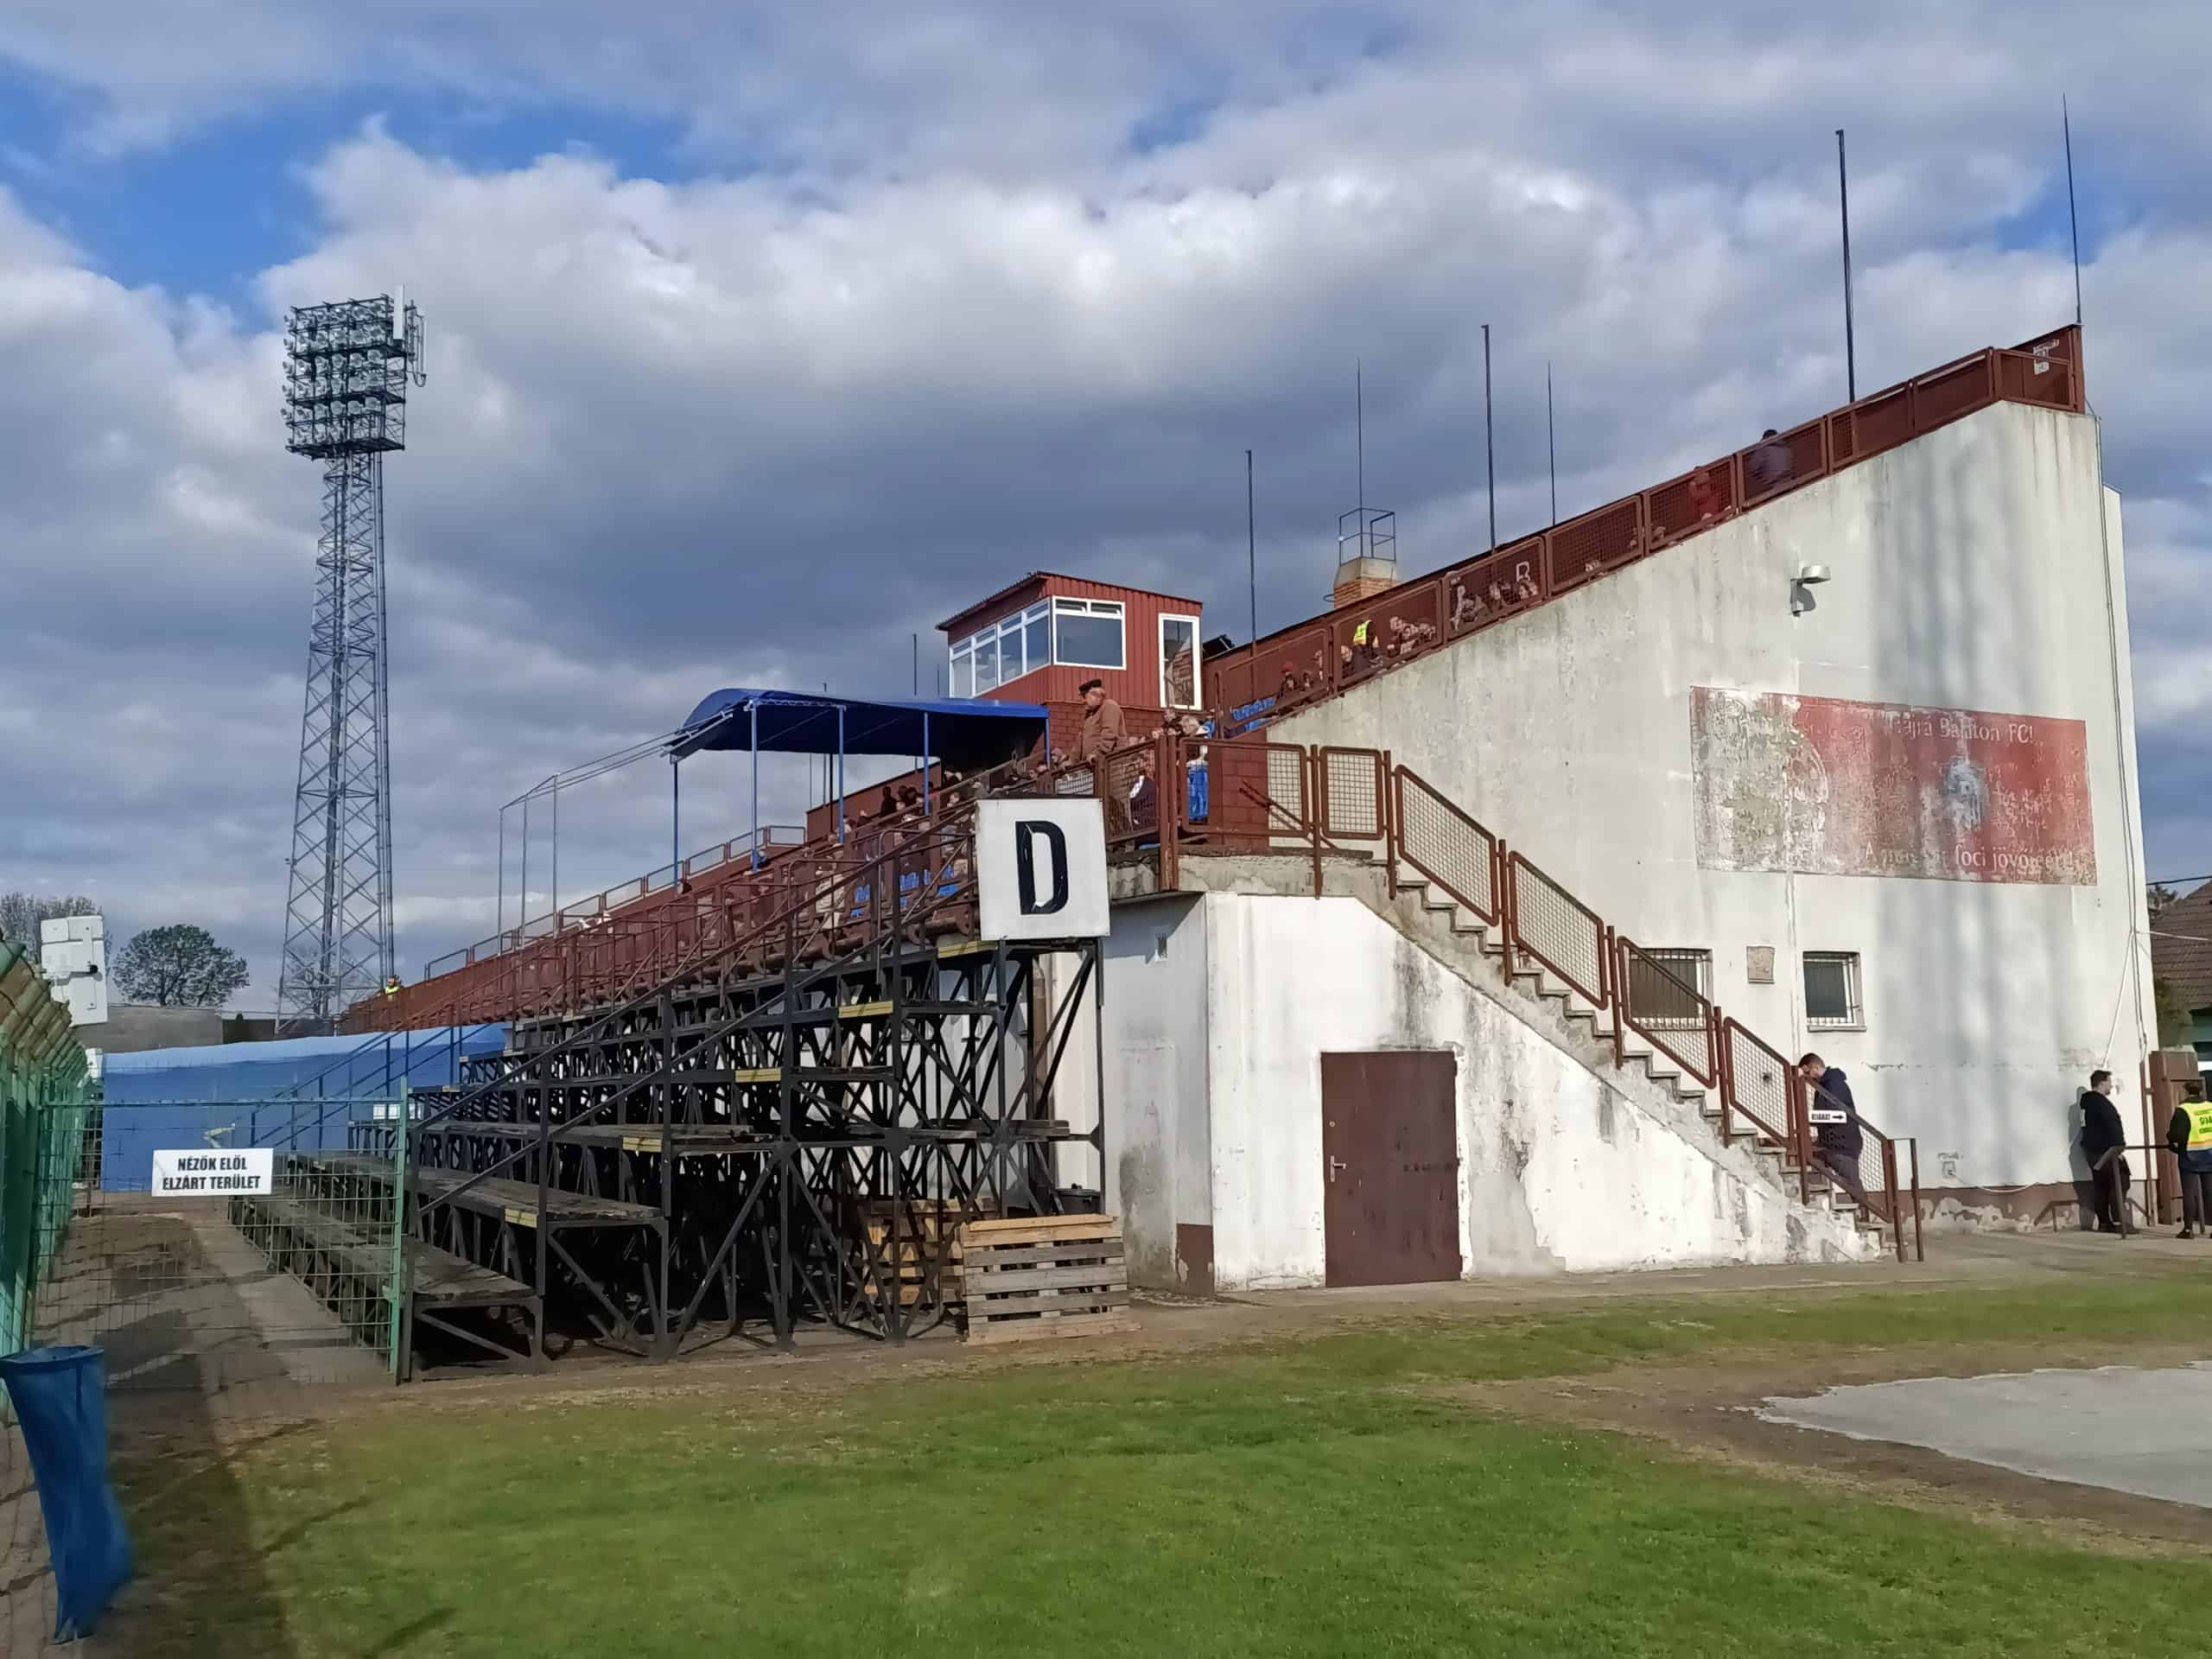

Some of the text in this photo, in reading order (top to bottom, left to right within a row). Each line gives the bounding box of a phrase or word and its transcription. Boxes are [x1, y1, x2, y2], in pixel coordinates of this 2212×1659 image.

[1015, 820, 1069, 915] D
[178, 1155, 217, 1171] NÉZŐK
[162, 1173, 261, 1190] ELZÁRT TERÜLET
